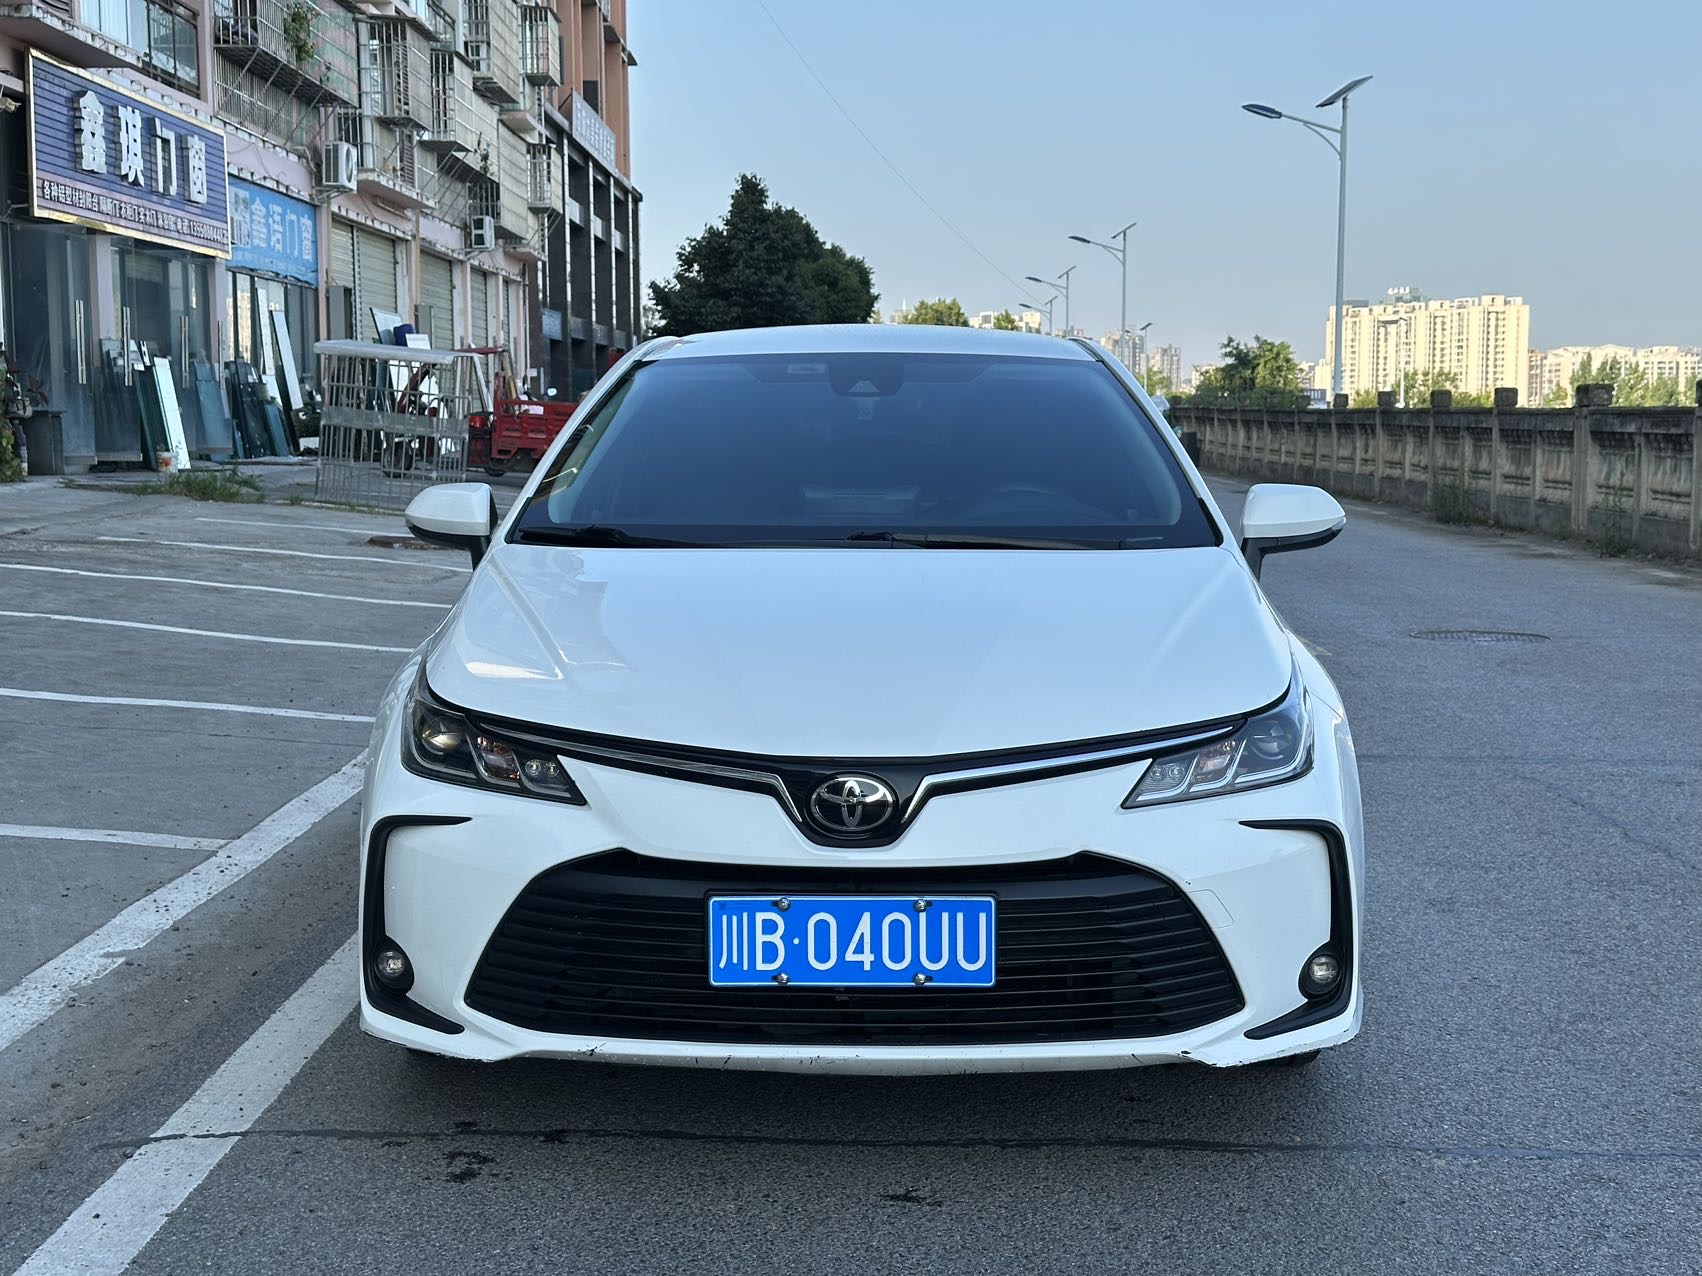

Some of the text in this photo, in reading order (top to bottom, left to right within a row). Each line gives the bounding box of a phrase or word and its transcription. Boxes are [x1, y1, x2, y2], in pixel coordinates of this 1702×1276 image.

[78, 90, 208, 204] 鑫琪门窗
[718, 911, 988, 972] 川B·040UU
